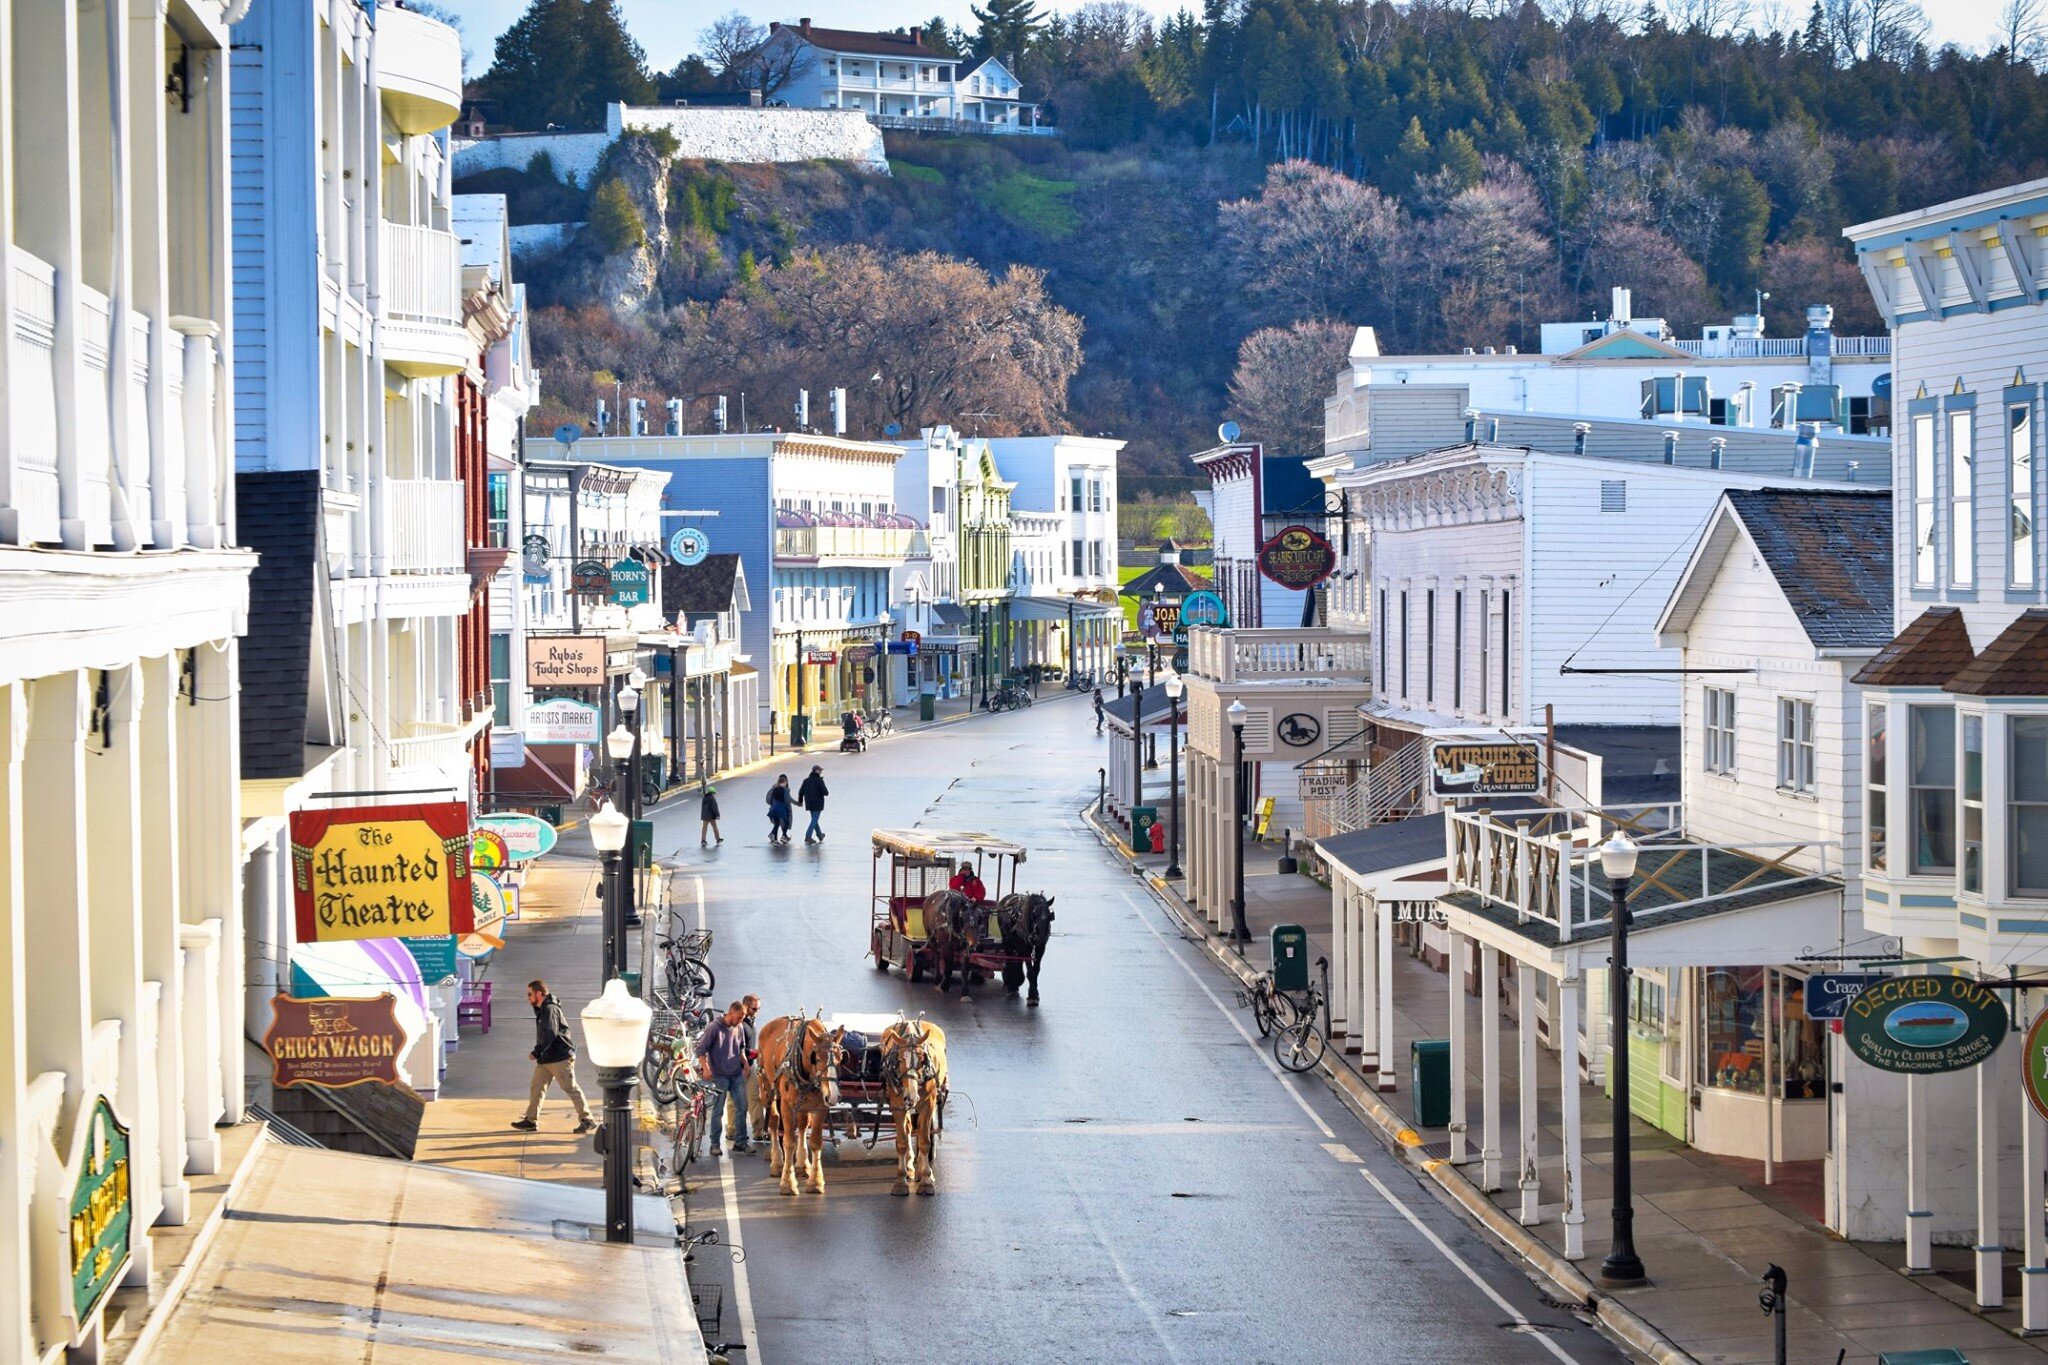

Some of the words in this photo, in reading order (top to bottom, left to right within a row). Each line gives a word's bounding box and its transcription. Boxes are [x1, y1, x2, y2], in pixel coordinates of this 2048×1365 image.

[611, 570, 647, 581] HORN'S
[619, 591, 639, 601] BAR
[549, 646, 584, 664] Ryba's
[532, 662, 564, 677] Fudge
[567, 663, 599, 677] Shops
[530, 712, 560, 724] ARTISTS
[562, 712, 593, 724] MARKET
[1435, 745, 1536, 774] MURDICK'S
[1301, 776, 1345, 786] TRADING
[1482, 764, 1536, 784] FUDGE
[1310, 786, 1337, 795] POST
[358, 827, 394, 846] The
[483, 831, 501, 844] TOYS
[316, 847, 438, 888] Haunted
[317, 892, 435, 928] Theatre
[1823, 979, 1865, 994] Crazy
[1852, 978, 1941, 1018] DECKED
[1951, 979, 1998, 1011] OUT
[274, 1034, 394, 1059] CHUCKWAGON
[1861, 1033, 1899, 1058] QUALITY
[1901, 1050, 1944, 1061] CLOTHES
[1960, 1034, 1989, 1056] SHOES
[1860, 1047, 1870, 1057] IN
[1873, 1054, 1891, 1067] THE
[1895, 1061, 1942, 1069] MACKINAC
[1948, 1044, 1993, 1066] TRADITION
